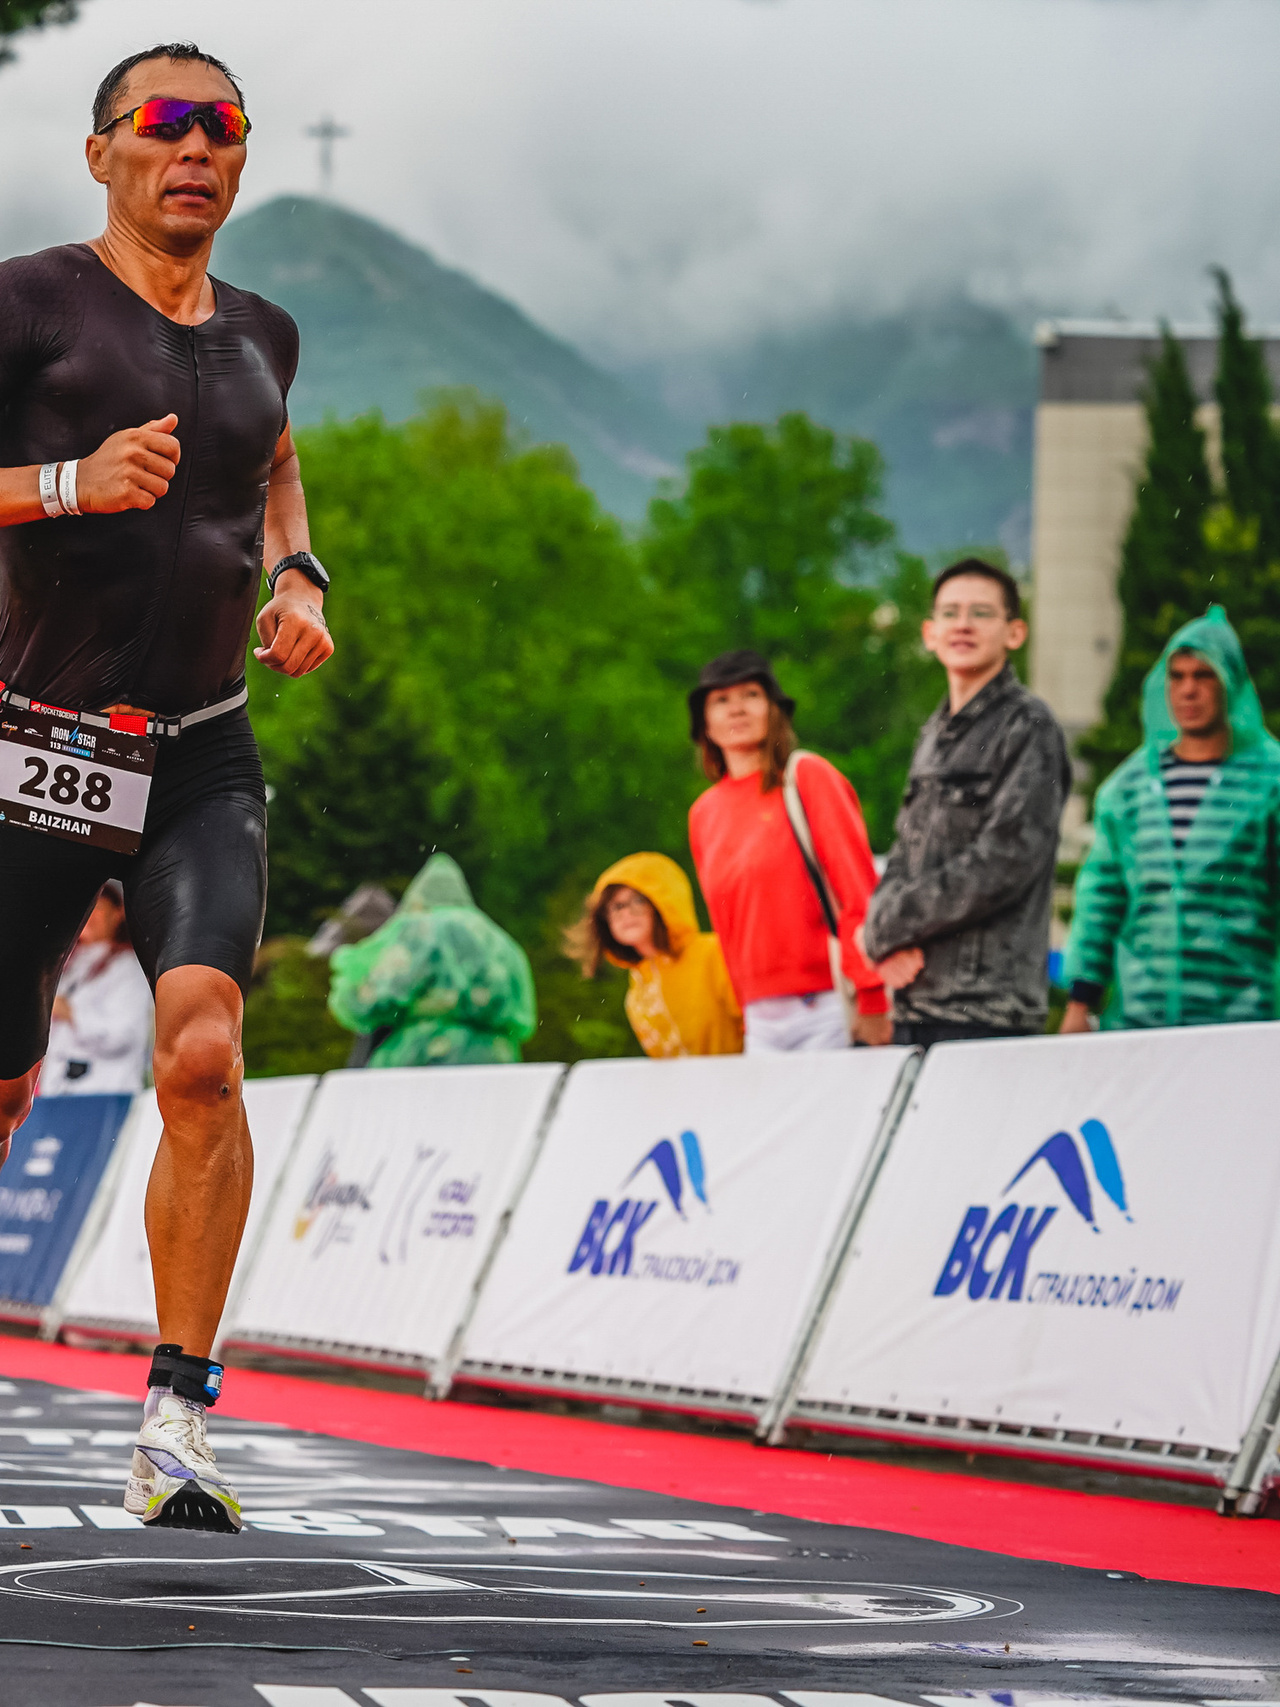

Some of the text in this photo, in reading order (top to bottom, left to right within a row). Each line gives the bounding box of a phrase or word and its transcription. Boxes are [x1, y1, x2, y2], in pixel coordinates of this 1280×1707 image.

[43, 469, 52, 490] ELITE
[50, 725, 70, 742] IRON
[77, 733, 97, 749] STAR
[50, 741, 61, 750] 113
[18, 756, 112, 813] 288
[28, 810, 92, 836] BAIZHAN
[568, 1199, 658, 1276] ВСК
[932, 1203, 1059, 1301] ВСК
[1027, 1267, 1185, 1318] СТРАХОВОЙ ДОМ
